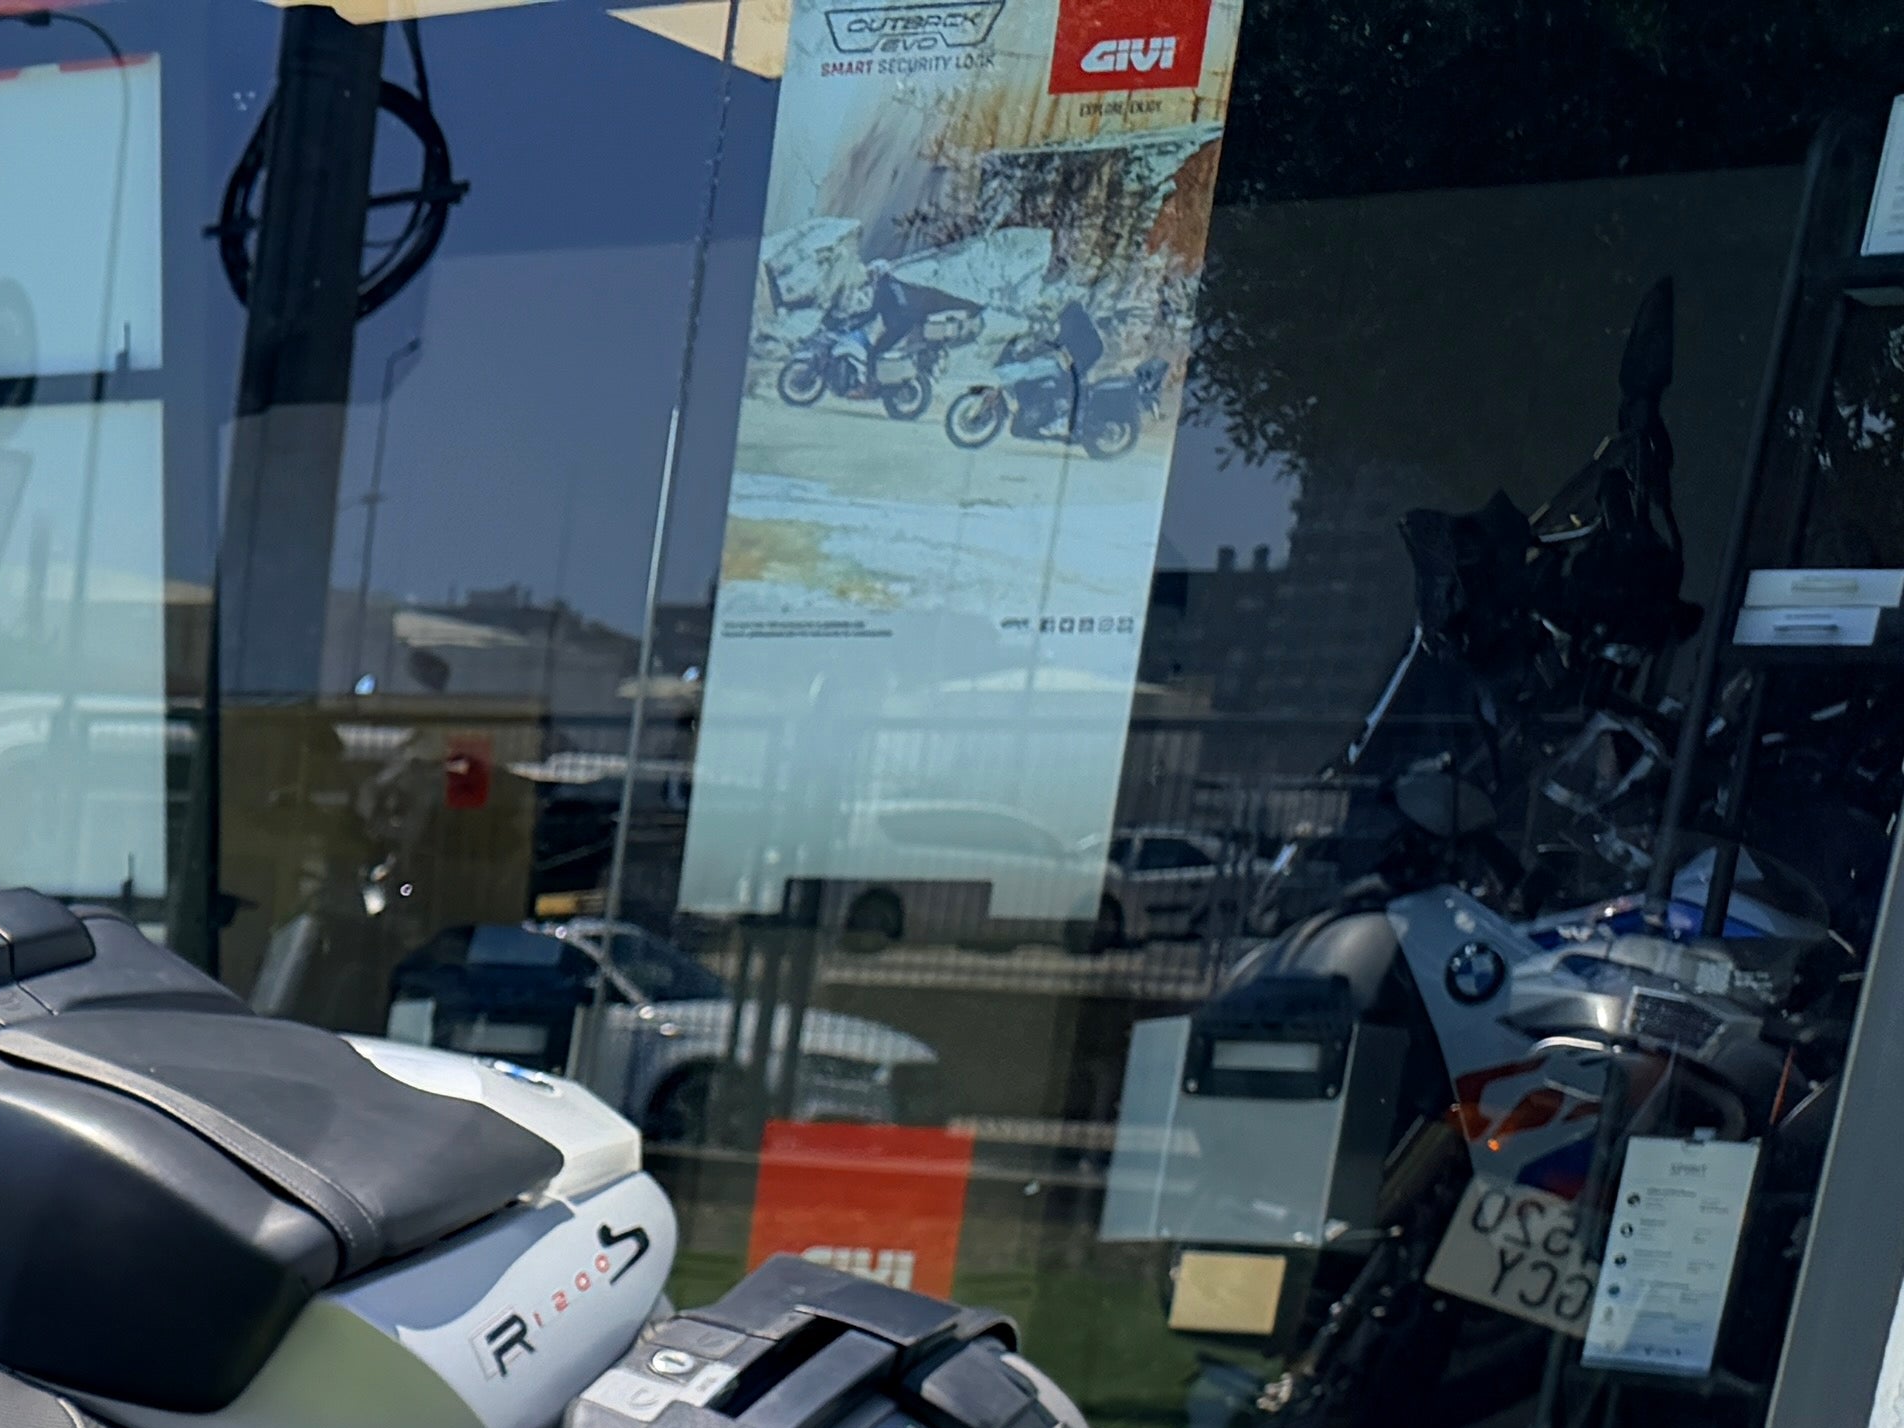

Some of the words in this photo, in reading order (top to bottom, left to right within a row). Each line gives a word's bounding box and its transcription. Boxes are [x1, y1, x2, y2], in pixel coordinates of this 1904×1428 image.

[880, 37, 938, 52] EVO
[1080, 36, 1177, 74] GIVI
[821, 59, 874, 77] SMART
[878, 55, 952, 75] SECURITY
[956, 53, 995, 70] LOCK
